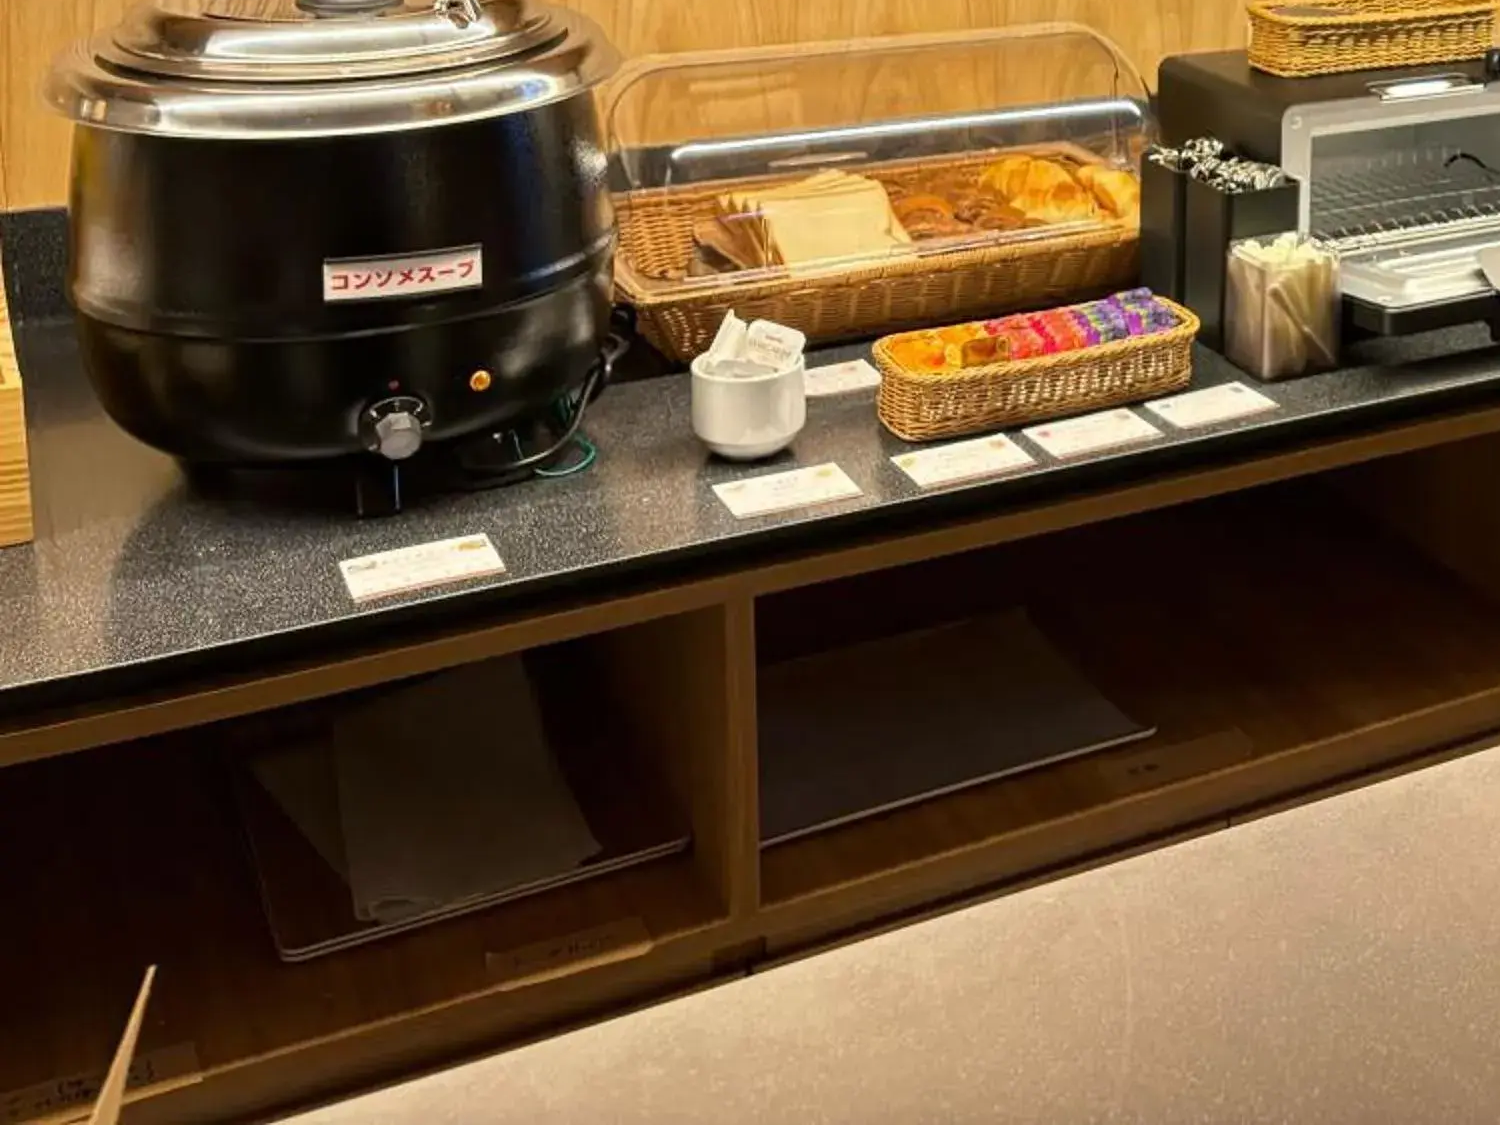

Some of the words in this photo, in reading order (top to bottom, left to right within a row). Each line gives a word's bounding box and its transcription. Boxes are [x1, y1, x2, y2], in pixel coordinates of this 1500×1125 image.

[331, 260, 475, 291] コンソメスープ
